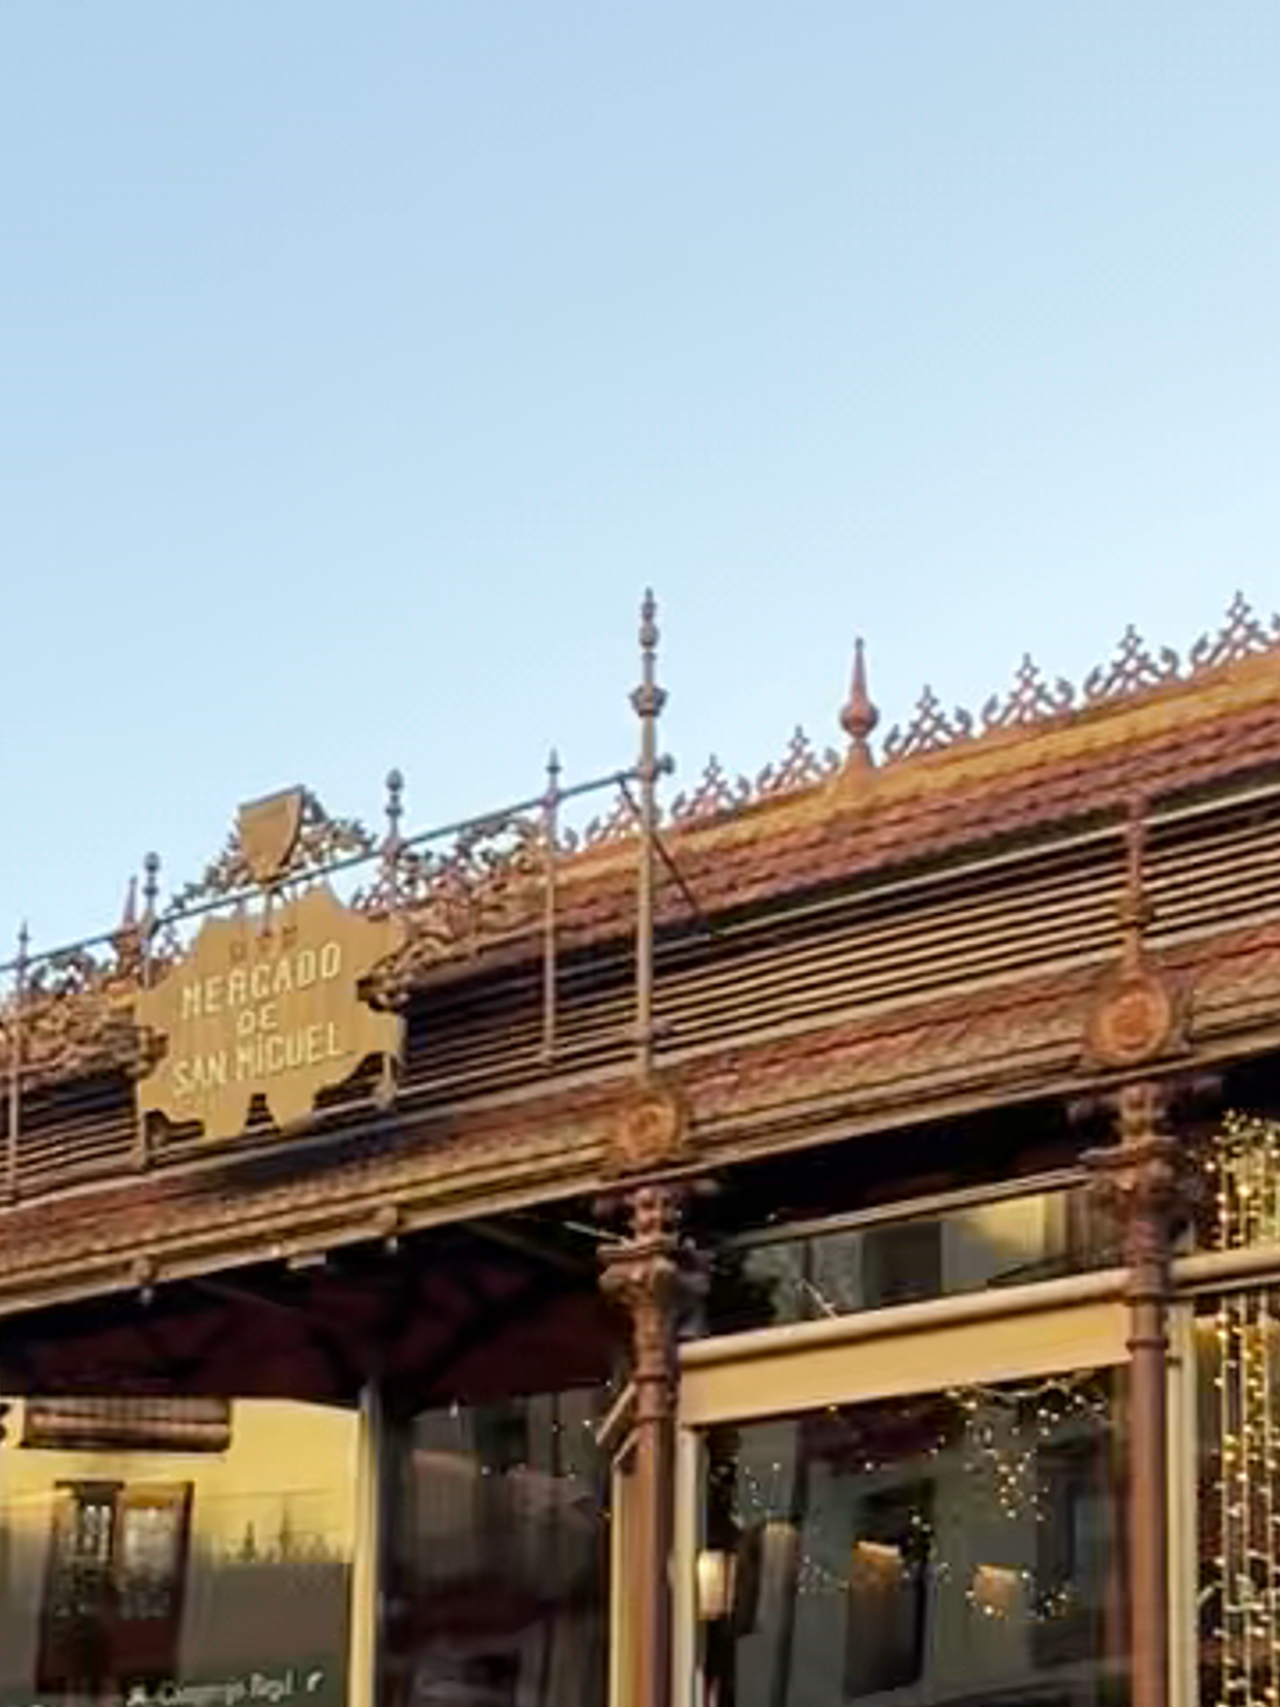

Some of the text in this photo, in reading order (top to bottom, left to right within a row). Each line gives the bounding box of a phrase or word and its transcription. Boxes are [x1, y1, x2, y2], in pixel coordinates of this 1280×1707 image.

[181, 940, 343, 1020] MERCADO
[235, 1003, 279, 1037] DE
[172, 1049, 228, 1096] SAN
